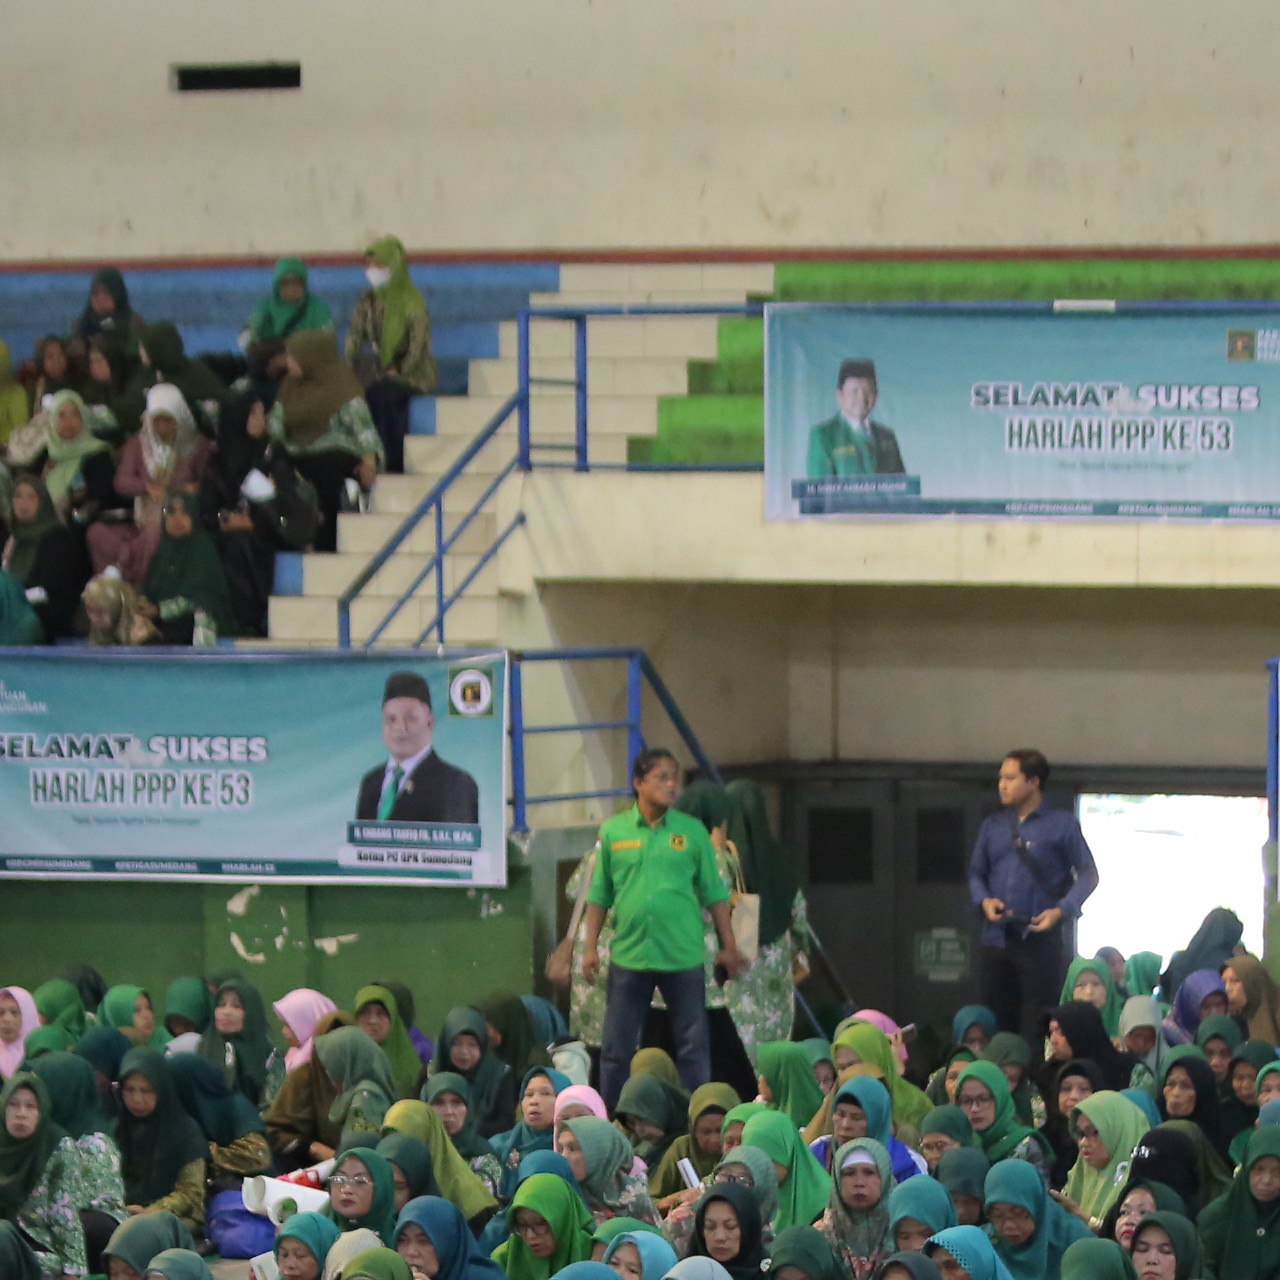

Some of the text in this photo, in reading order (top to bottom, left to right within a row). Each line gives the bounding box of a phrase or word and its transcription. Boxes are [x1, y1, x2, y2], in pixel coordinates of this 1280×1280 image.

[972, 382, 1122, 409] SELAMAT
[1137, 384, 1260, 411] SUKSES
[1006, 417, 1233, 452] HARLAH PPP KE 53
[148, 736, 268, 762] SUKSES
[31, 769, 252, 807] HARLAH PPP KE 53
